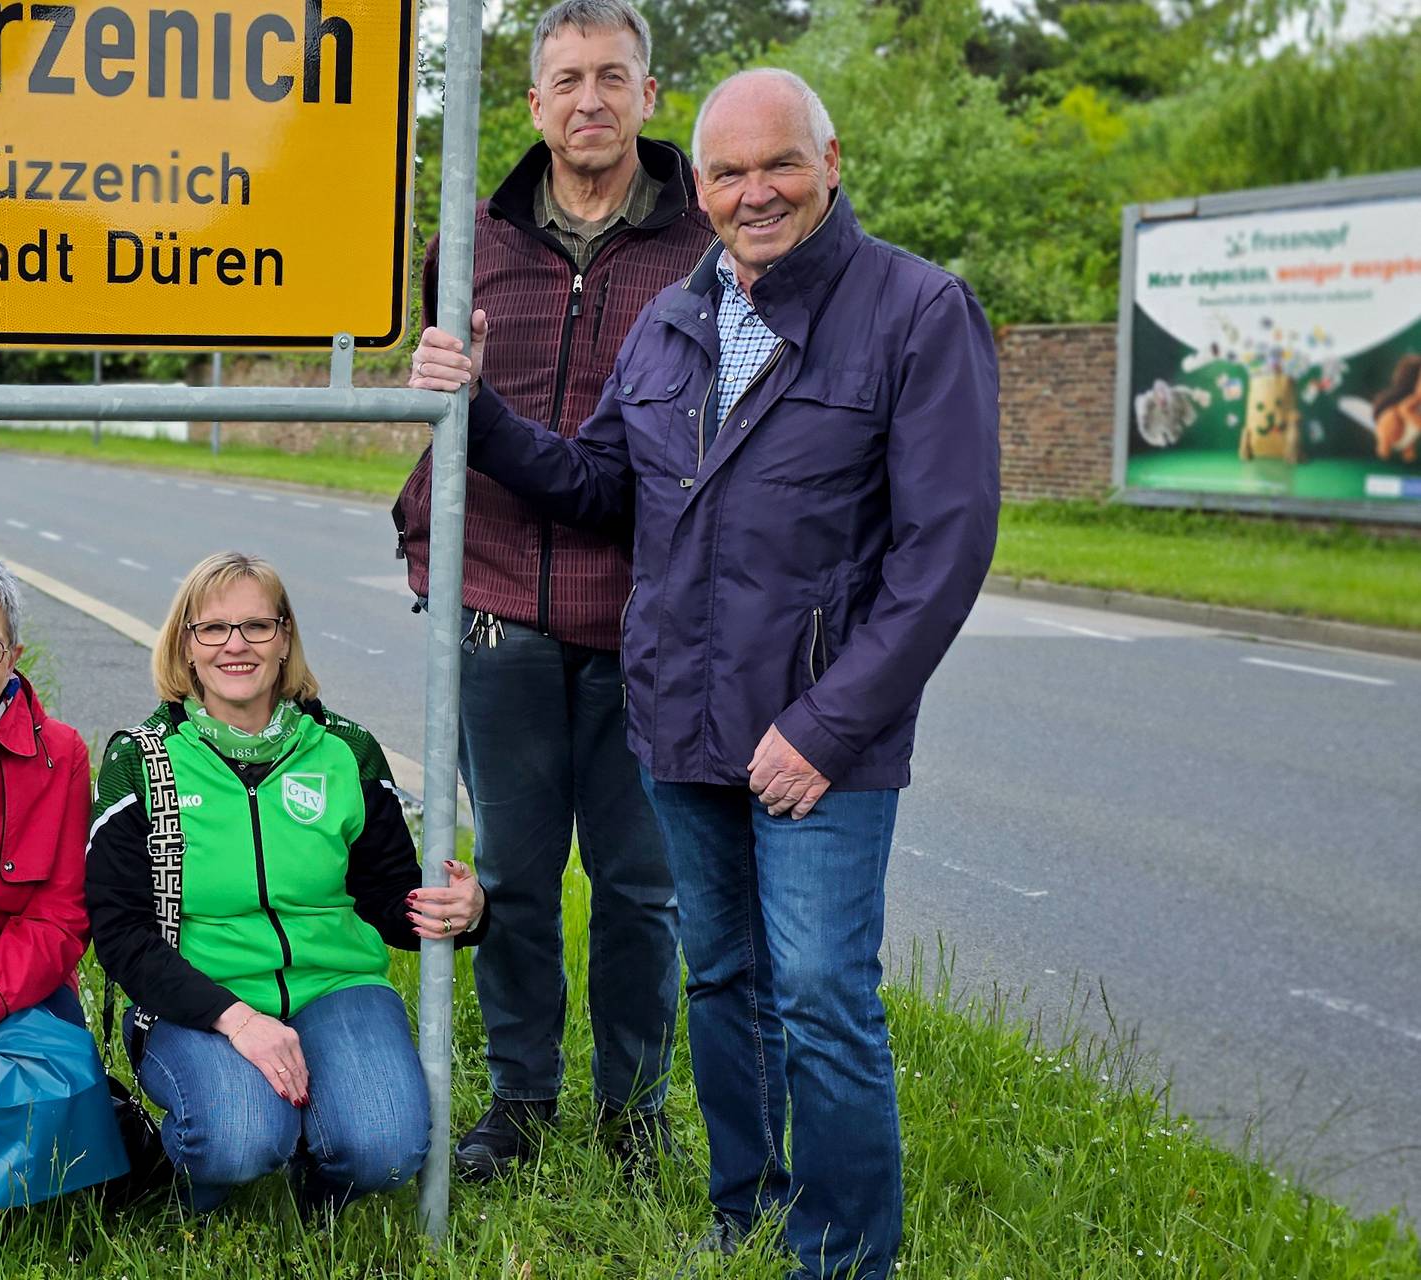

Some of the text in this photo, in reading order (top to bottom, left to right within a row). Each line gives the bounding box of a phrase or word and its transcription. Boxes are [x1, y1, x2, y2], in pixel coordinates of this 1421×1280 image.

[1250, 223, 1350, 250] fressnapf
[105, 229, 284, 287] Düren
[230, 747, 259, 759] 1881
[178, 795, 202, 808] AKO
[288, 783, 321, 809] GTV
